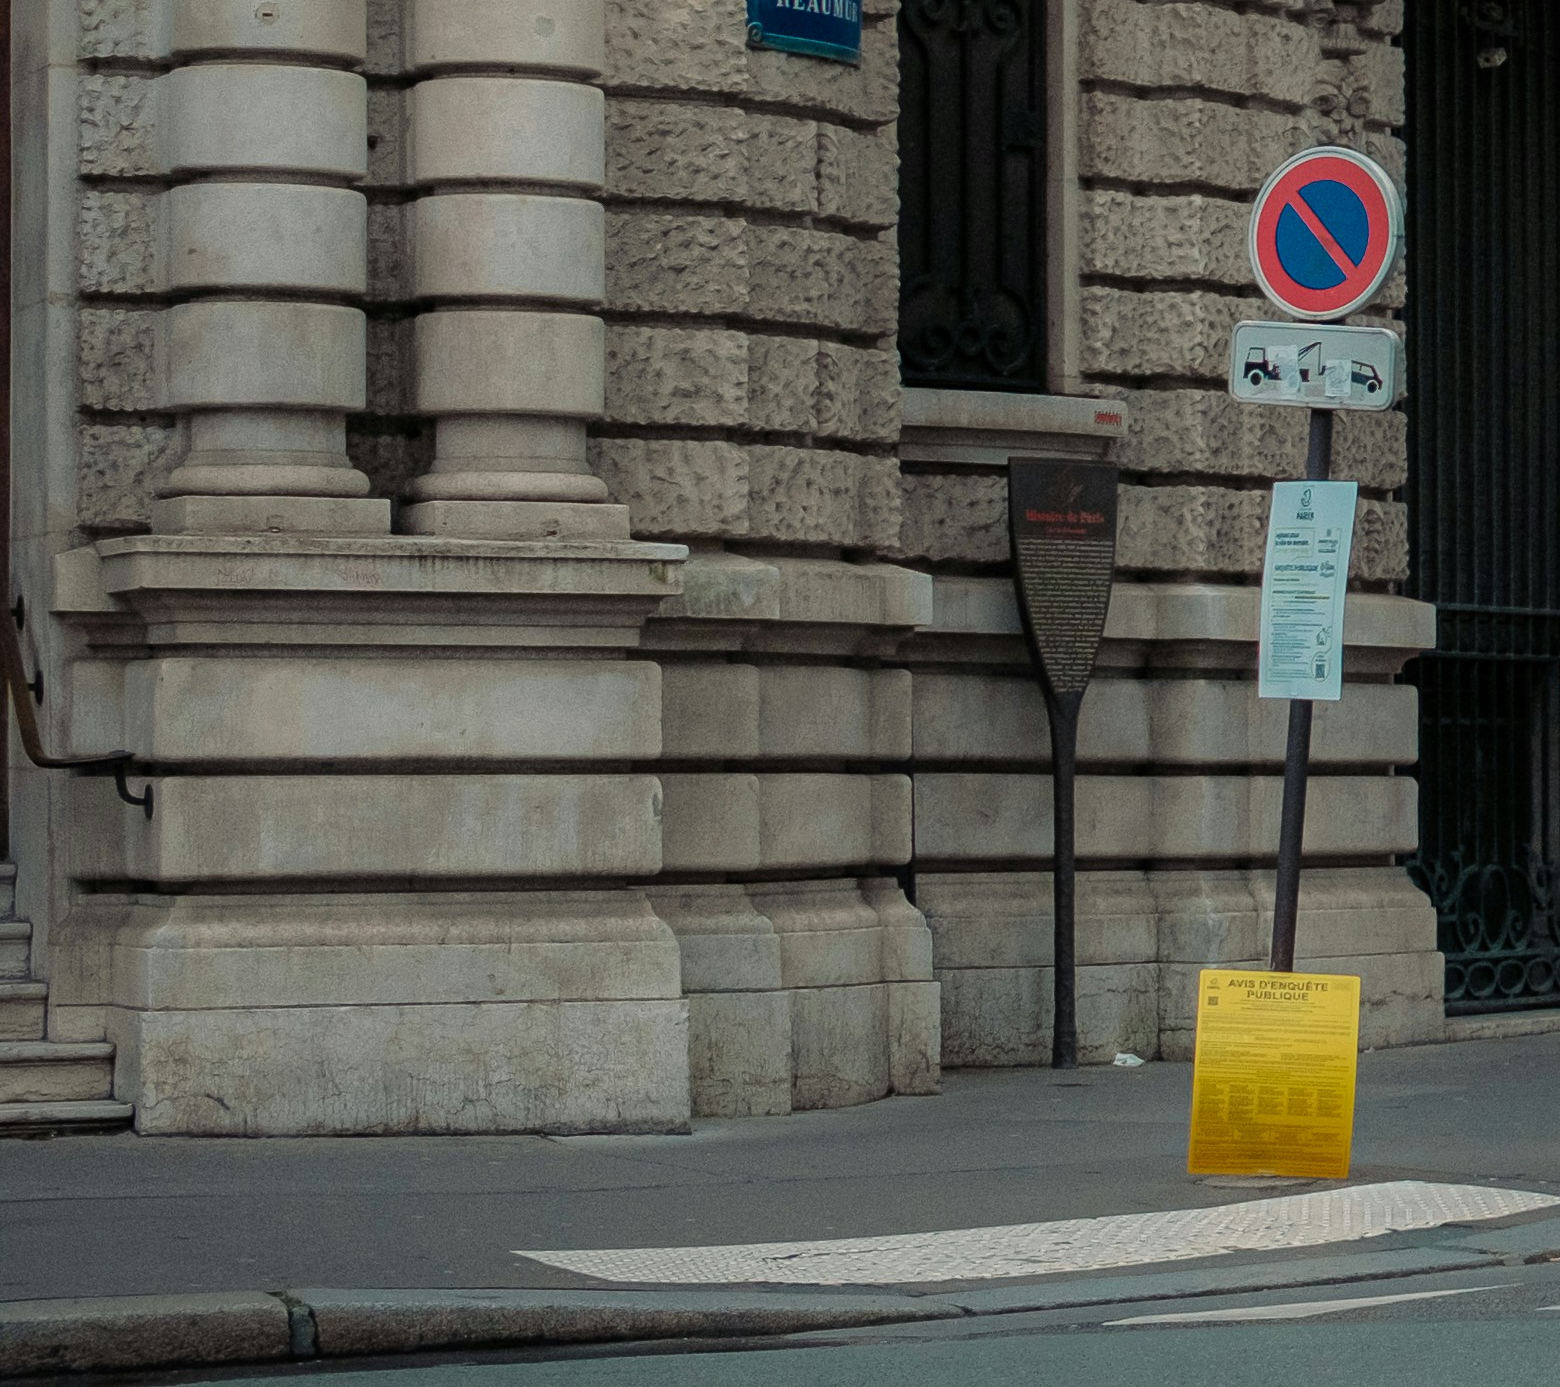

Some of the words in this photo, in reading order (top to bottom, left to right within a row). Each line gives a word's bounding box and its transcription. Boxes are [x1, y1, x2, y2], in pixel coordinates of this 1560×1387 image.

[1228, 978, 1256, 989] AVIS
[1258, 979, 1329, 992] D'ENQUÊTE
[1246, 990, 1310, 1001] PUBLIQUE
